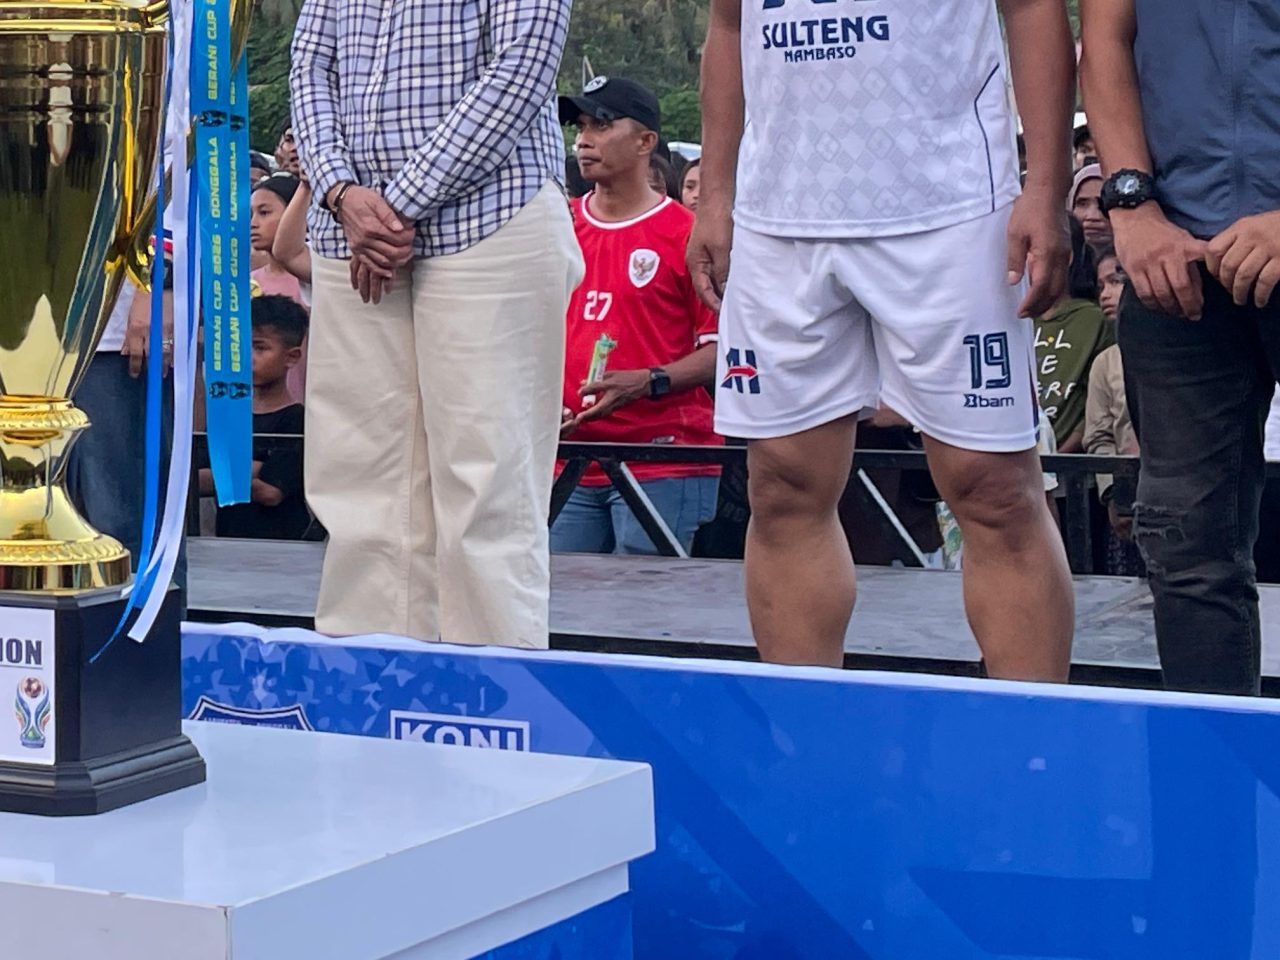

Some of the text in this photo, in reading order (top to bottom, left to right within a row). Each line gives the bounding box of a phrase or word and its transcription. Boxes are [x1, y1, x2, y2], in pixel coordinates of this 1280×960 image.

[207, 10, 217, 39] CUP
[762, 15, 890, 50] SULTENG
[784, 45, 856, 63] NAMBASO
[209, 137, 220, 218] DONGGALA
[583, 290, 612, 321] 27
[963, 331, 1011, 389] 19
